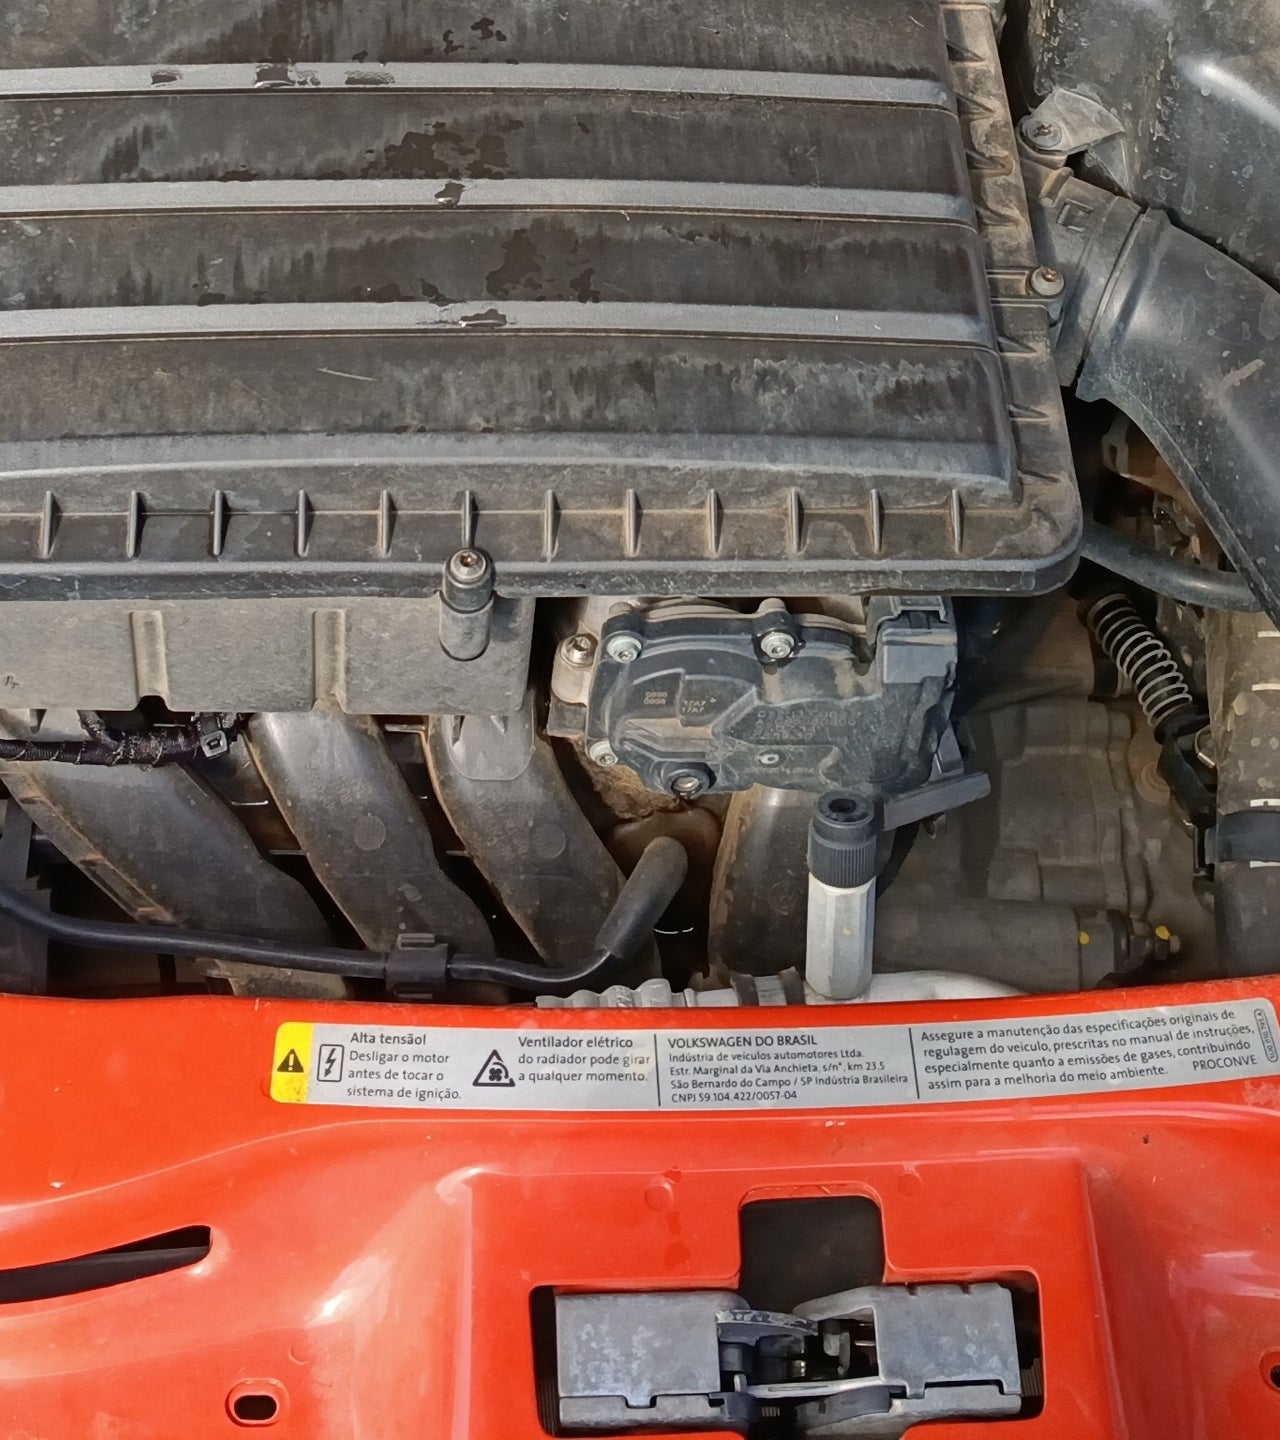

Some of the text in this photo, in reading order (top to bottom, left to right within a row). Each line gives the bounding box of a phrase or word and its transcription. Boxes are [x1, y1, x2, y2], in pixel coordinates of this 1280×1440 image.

[920, 1009, 1235, 1044] Assegure a manutenção das especificações originais de
[350, 1032, 376, 1044] Alta
[518, 1036, 633, 1048] Ventilador elétrico
[668, 1034, 817, 1049] VOLKSWAGEN DO BRASIL
[923, 1042, 987, 1061] regulagem
[990, 1041, 1005, 1054] do
[1053, 1036, 1109, 1052] prescritas
[1111, 1036, 1127, 1047] no
[1129, 1030, 1174, 1045] manual
[1176, 1027, 1191, 1040] de
[349, 1050, 450, 1065] Desligar o motor
[518, 1053, 650, 1069] do radiador pode girar
[669, 1049, 864, 1063] Indústria de veículos automotores Ltda.
[924, 1039, 1251, 1076] especialmente quanto a emissões de gases, contribuindo
[1192, 1054, 1258, 1072] PROCONVE
[347, 1068, 443, 1081] antes de tocar o
[670, 1066, 691, 1076] Estr.
[693, 1064, 738, 1077] Marginal
[740, 1064, 753, 1074] da
[756, 1064, 771, 1074] Via
[847, 1061, 862, 1071] km
[518, 1070, 648, 1085] a qualquer momento.
[670, 1079, 689, 1090] São
[691, 1078, 738, 1088] Bernardo
[740, 1077, 753, 1087] do
[755, 1076, 791, 1089] Campo
[800, 1076, 813, 1086] SP
[815, 1074, 860, 1086] Indústria
[862, 1073, 908, 1084] Brasileira
[928, 1076, 962, 1090] assim
[965, 1076, 991, 1090] para
[994, 1076, 1001, 1085] a
[1003, 1070, 1056, 1084] melhoria
[1059, 1070, 1074, 1082] do
[1077, 1068, 1107, 1081] meio
[346, 1085, 461, 1103] sistema de ignição.
[671, 1092, 696, 1103] CNPJ
